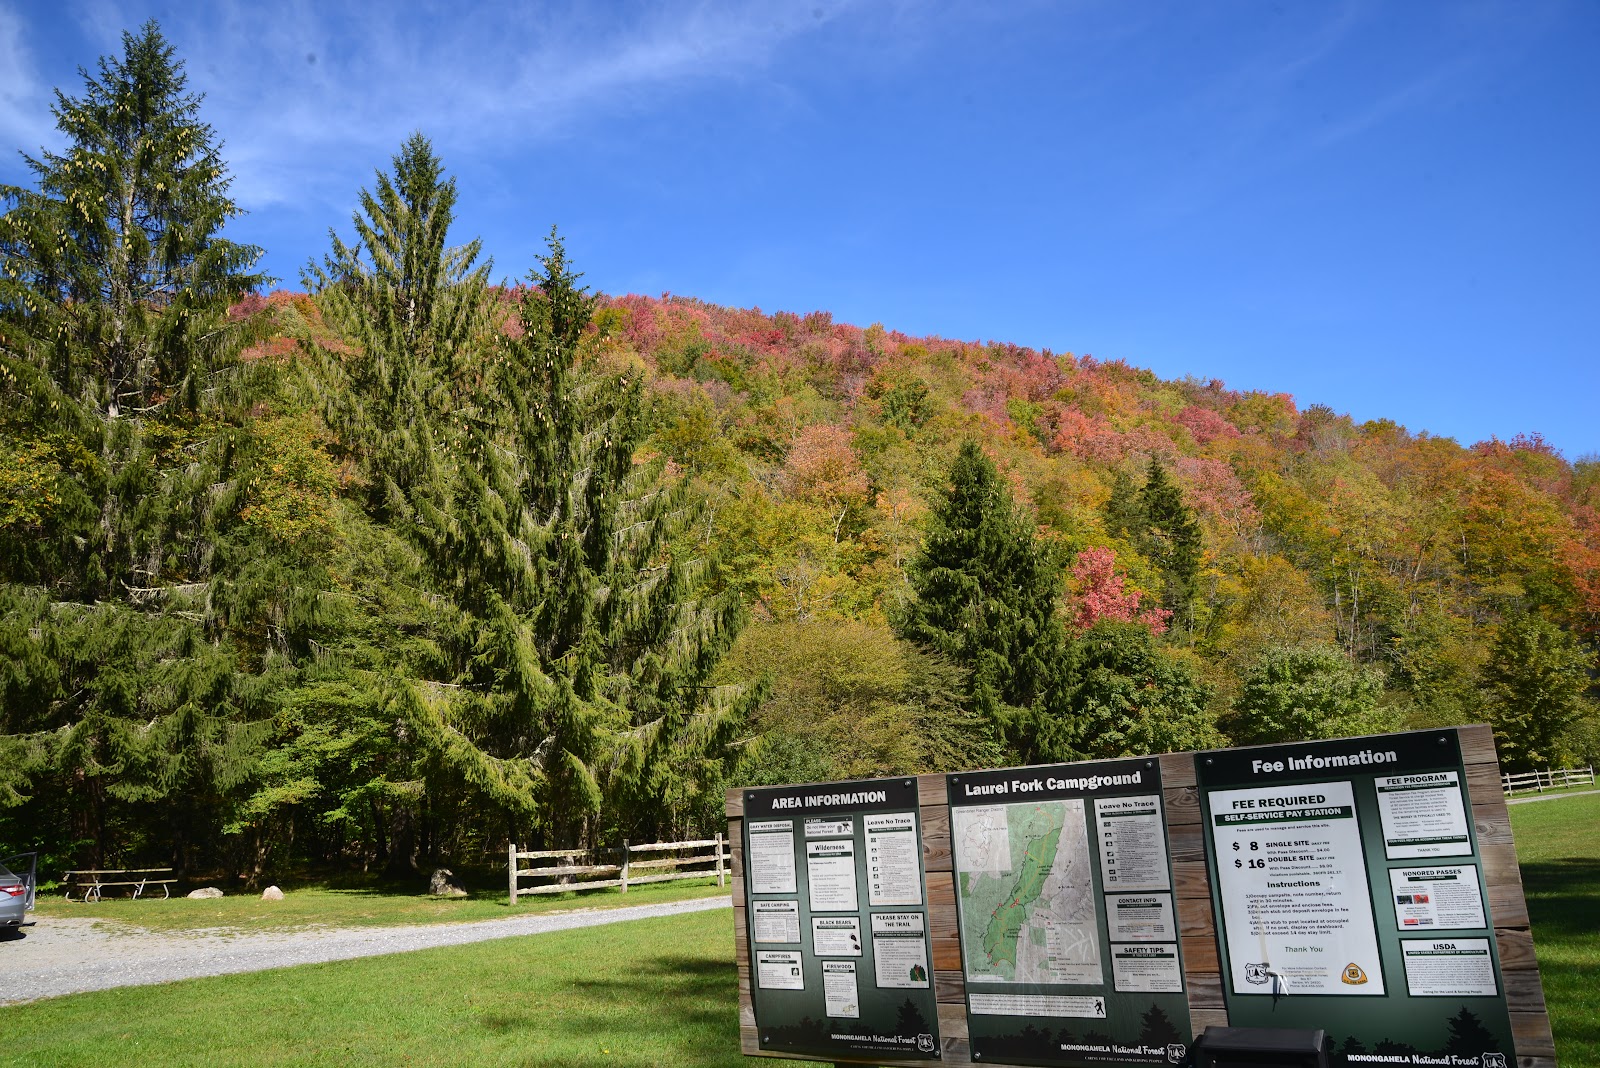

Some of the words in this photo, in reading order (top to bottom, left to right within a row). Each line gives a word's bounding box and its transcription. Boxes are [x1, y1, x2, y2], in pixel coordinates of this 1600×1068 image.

[1253, 760, 1284, 773] Fee
[1288, 750, 1397, 771] Information
[965, 781, 1008, 796] Laurel
[1012, 779, 1043, 793] Fork
[1046, 771, 1142, 790] Campground
[1404, 775, 1447, 783] PROGRAM
[772, 798, 802, 809] AREA
[804, 790, 886, 807] INFORMATION
[1232, 800, 1255, 809] FEE
[1259, 795, 1326, 808] REQUIRED
[1224, 812, 1284, 822] SELF-SERVICE
[1304, 808, 1341, 816] STATION
[1233, 842, 1240, 851] $
[1250, 842, 1258, 851] 8
[1234, 859, 1242, 868] $
[1249, 859, 1265, 869] 16
[873, 1035, 897, 1043] National
[1112, 1045, 1141, 1054] National
[1142, 1046, 1165, 1055] Forest
[1348, 1055, 1410, 1063] MONONGAHELA
[1412, 1055, 1450, 1065] National
[1452, 1055, 1478, 1066] Forest
